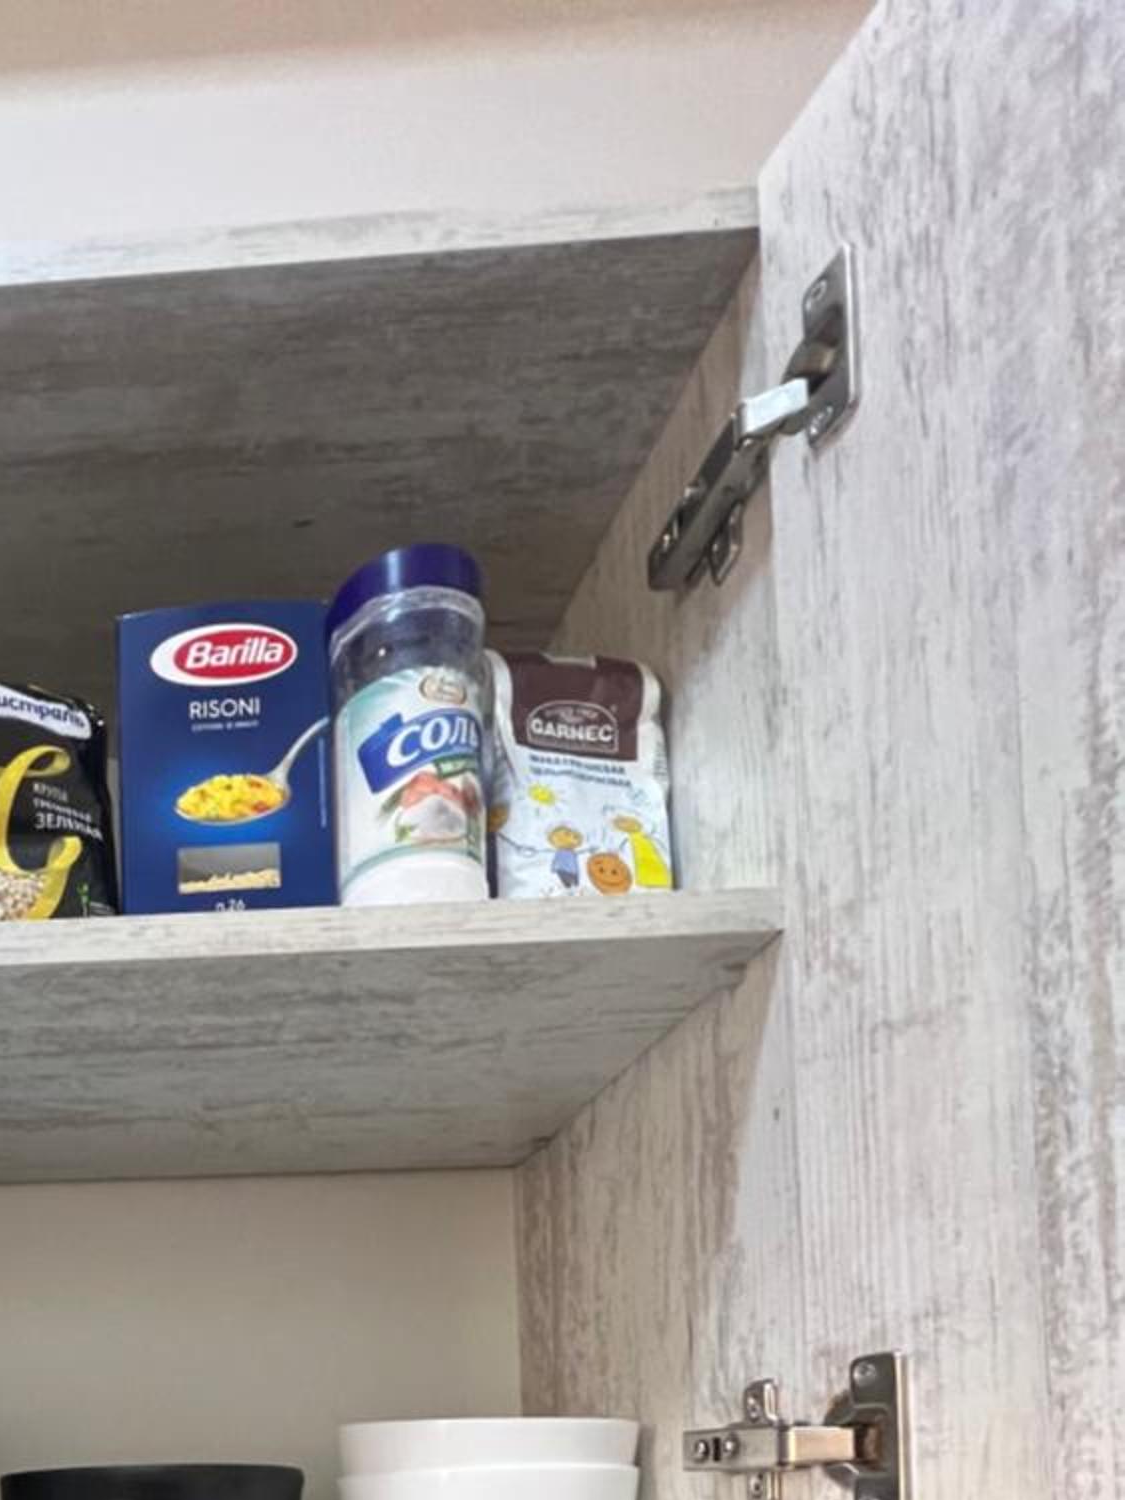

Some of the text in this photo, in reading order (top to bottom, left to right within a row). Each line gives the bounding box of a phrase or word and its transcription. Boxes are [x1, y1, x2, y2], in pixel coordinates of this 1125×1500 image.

[186, 637, 285, 669] Barilla
[189, 697, 260, 719] RISONI
[531, 718, 613, 742] GARNEC
